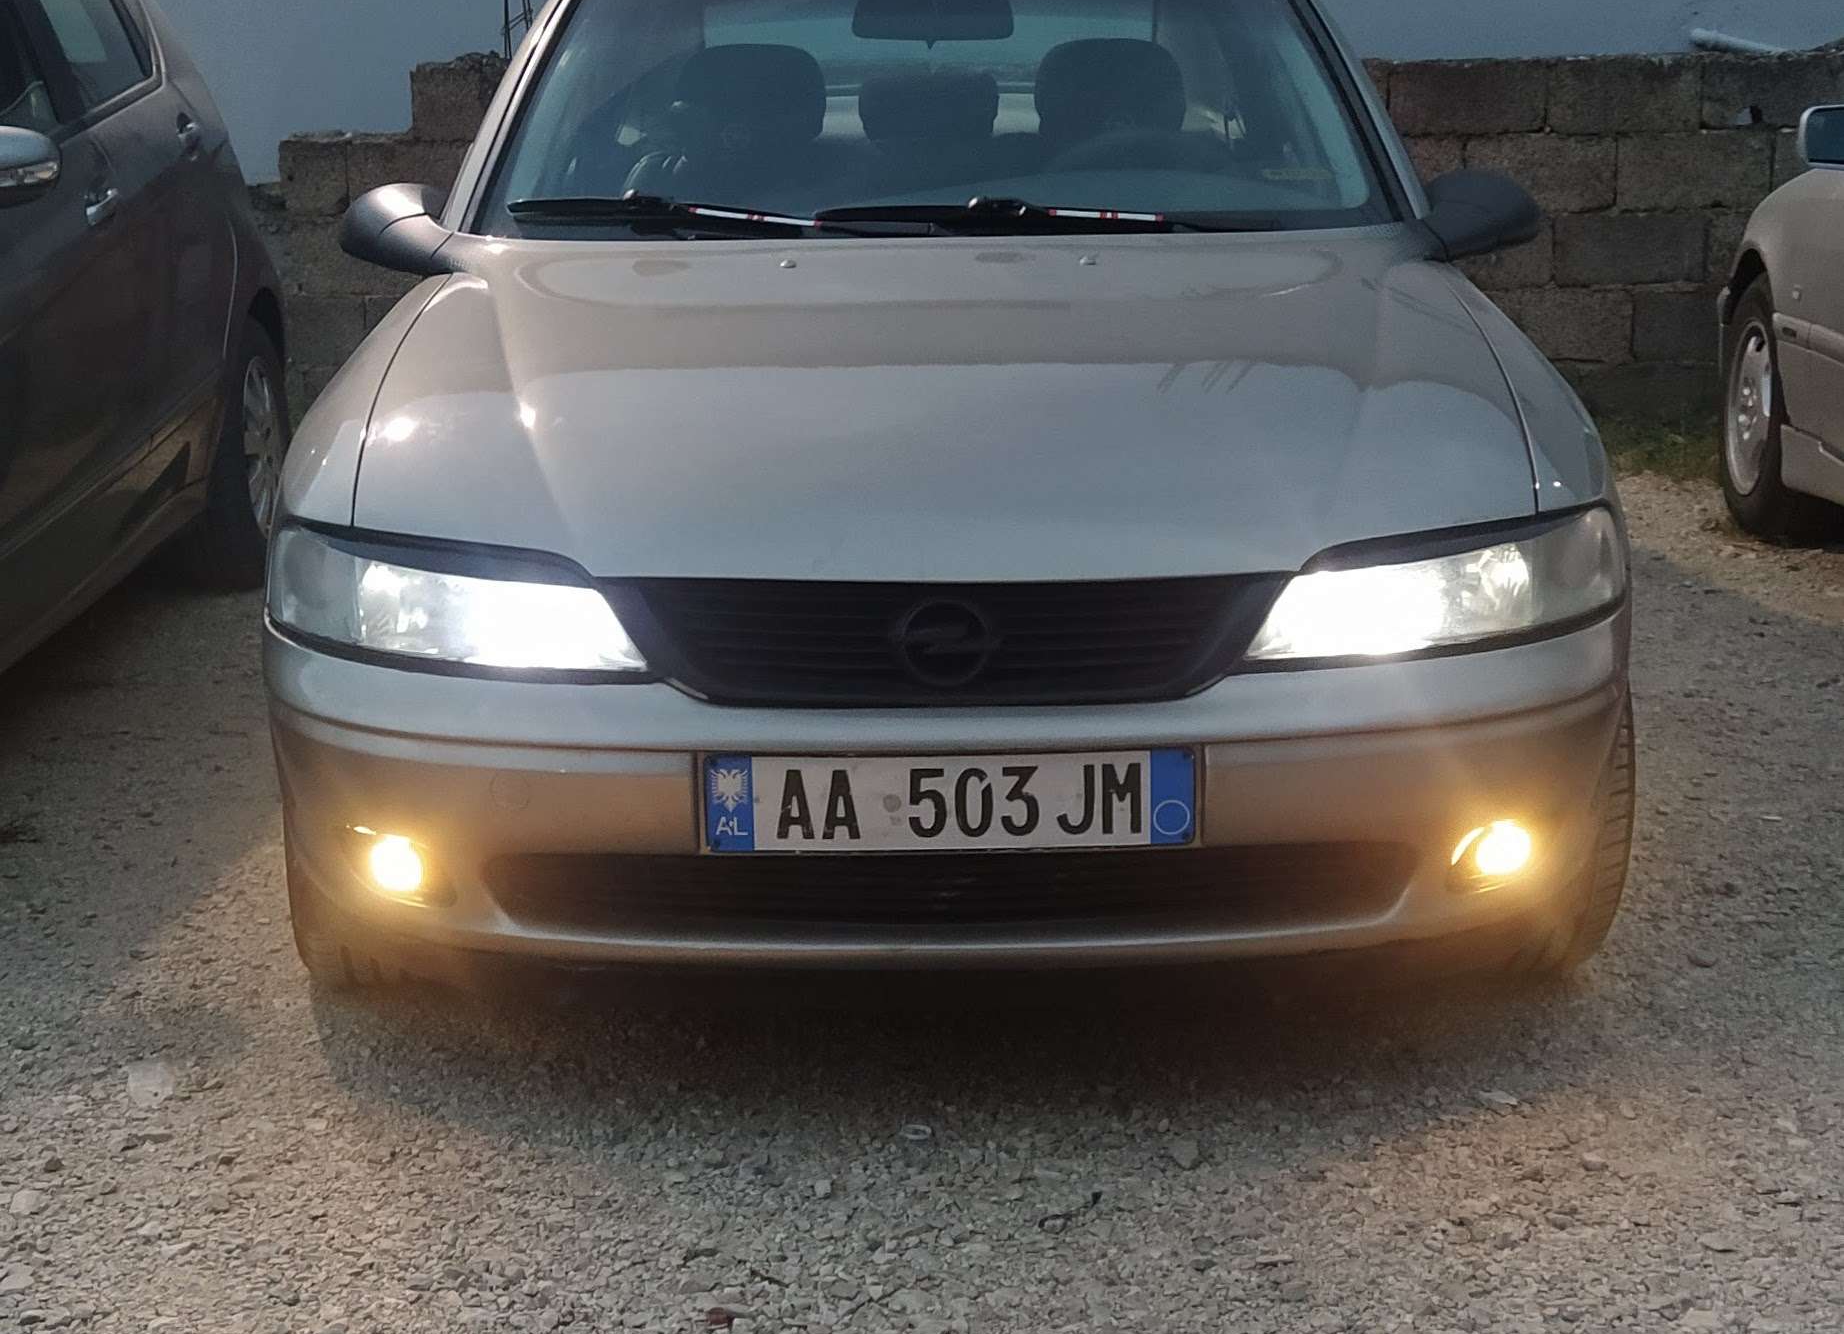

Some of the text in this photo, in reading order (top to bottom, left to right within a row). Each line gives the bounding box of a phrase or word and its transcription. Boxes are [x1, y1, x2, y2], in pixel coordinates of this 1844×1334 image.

[776, 763, 1143, 840] AA 503 JM
[715, 816, 749, 836] AL
